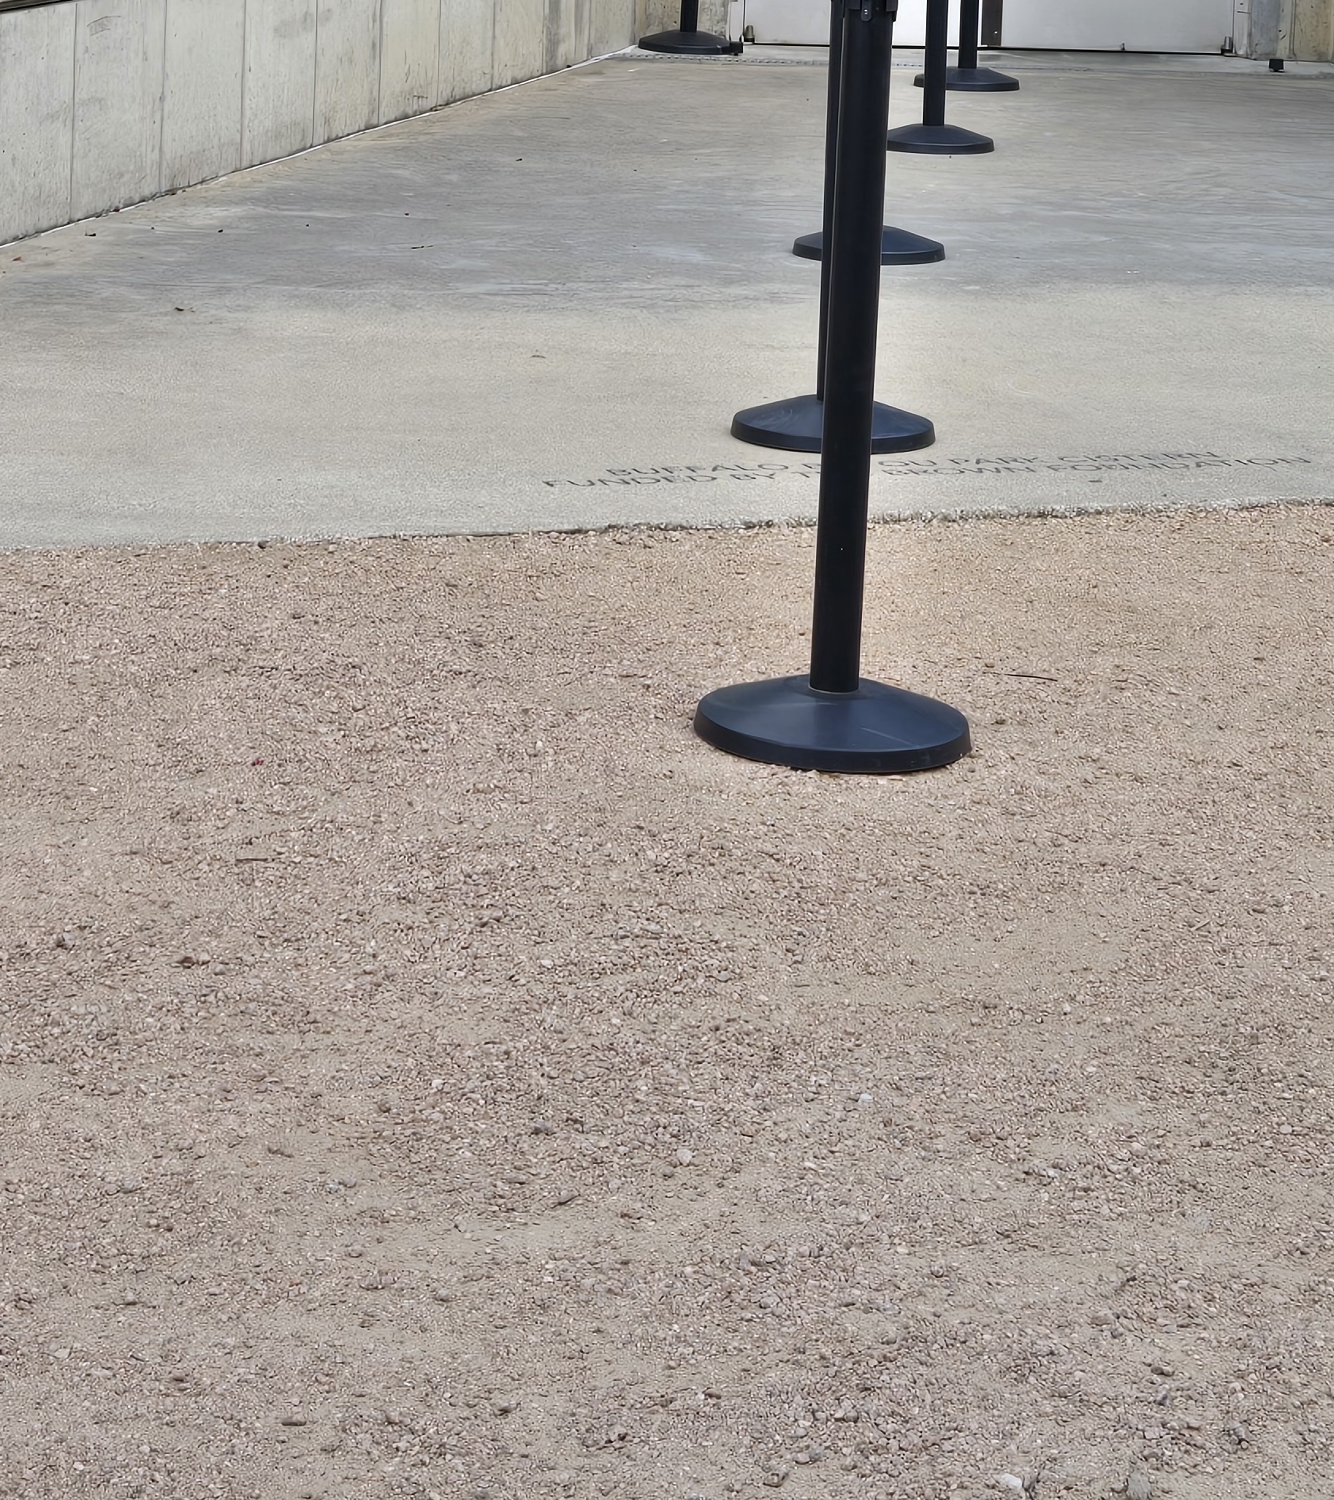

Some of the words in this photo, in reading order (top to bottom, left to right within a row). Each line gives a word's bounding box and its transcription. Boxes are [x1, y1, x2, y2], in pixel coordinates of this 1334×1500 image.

[542, 474, 718, 488] FUNDED
[729, 471, 777, 481] BY
[881, 466, 1037, 476] BROWN
[1046, 456, 1312, 472] FOUNDATION
[605, 462, 790, 476] BUFFALO
[801, 459, 937, 470] BOU
[948, 456, 1038, 466] PARK
[1058, 451, 1220, 463] CISTERN
